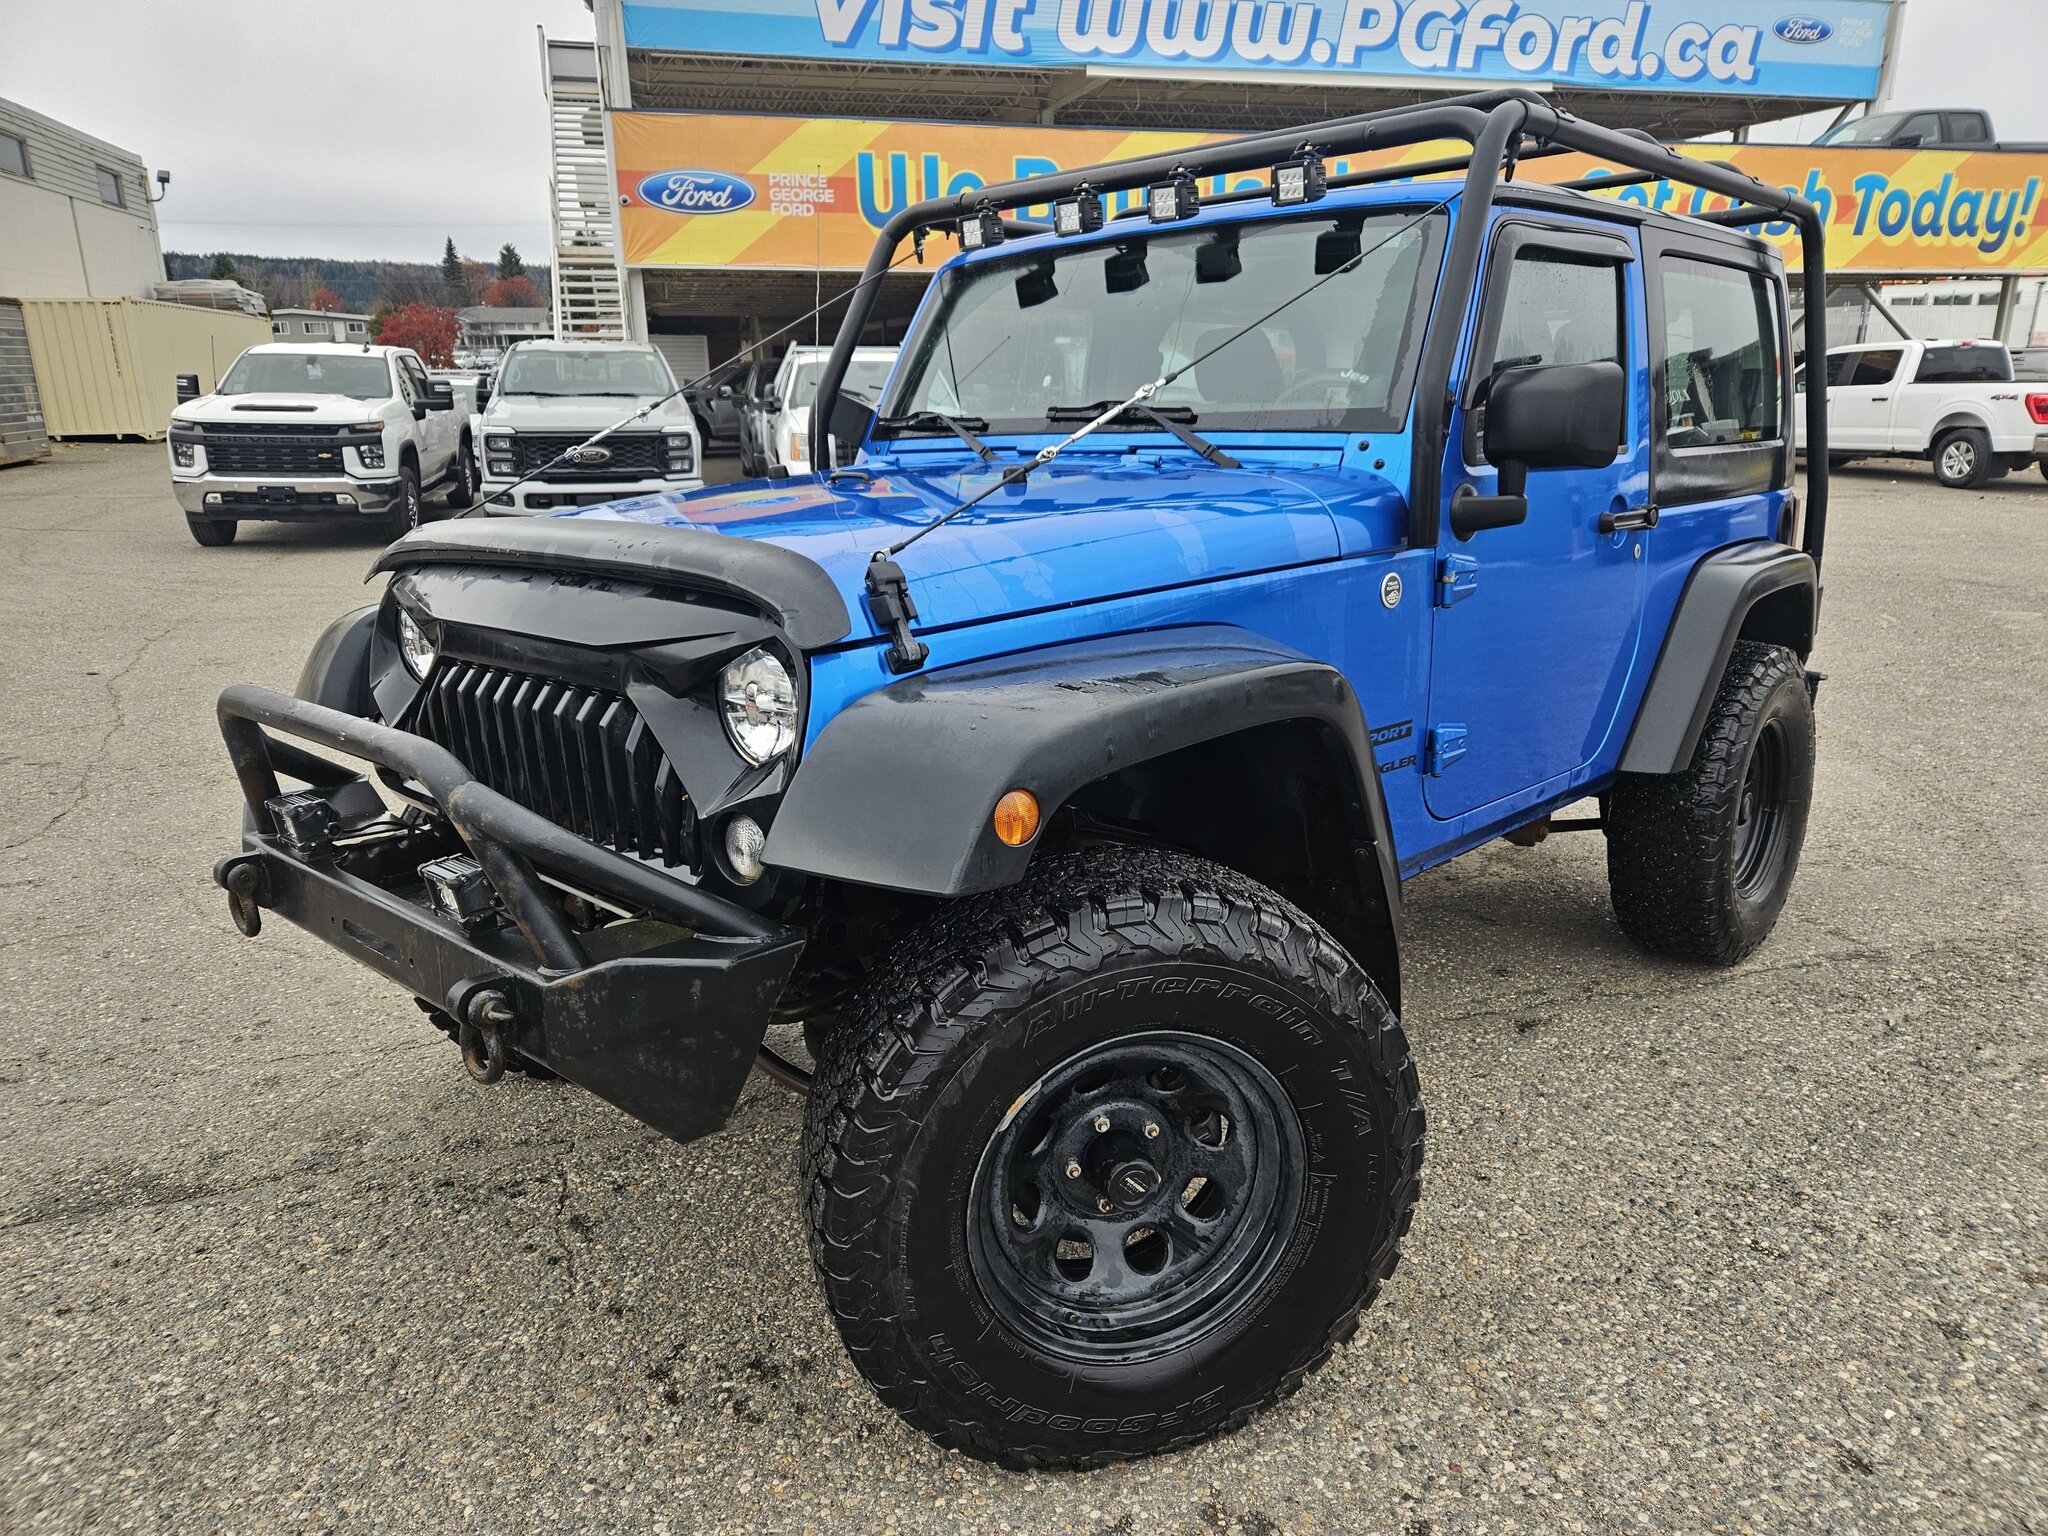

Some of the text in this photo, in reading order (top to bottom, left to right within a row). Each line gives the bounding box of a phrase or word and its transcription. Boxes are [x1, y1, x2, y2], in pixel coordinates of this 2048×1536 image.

[768, 172, 828, 188] PRINCE
[769, 188, 835, 203] GEORGE
[770, 202, 815, 217] FORD
[1853, 172, 2041, 254] Today!
[203, 435, 339, 444] CHEVROLET
[1370, 723, 1414, 742] PORT
